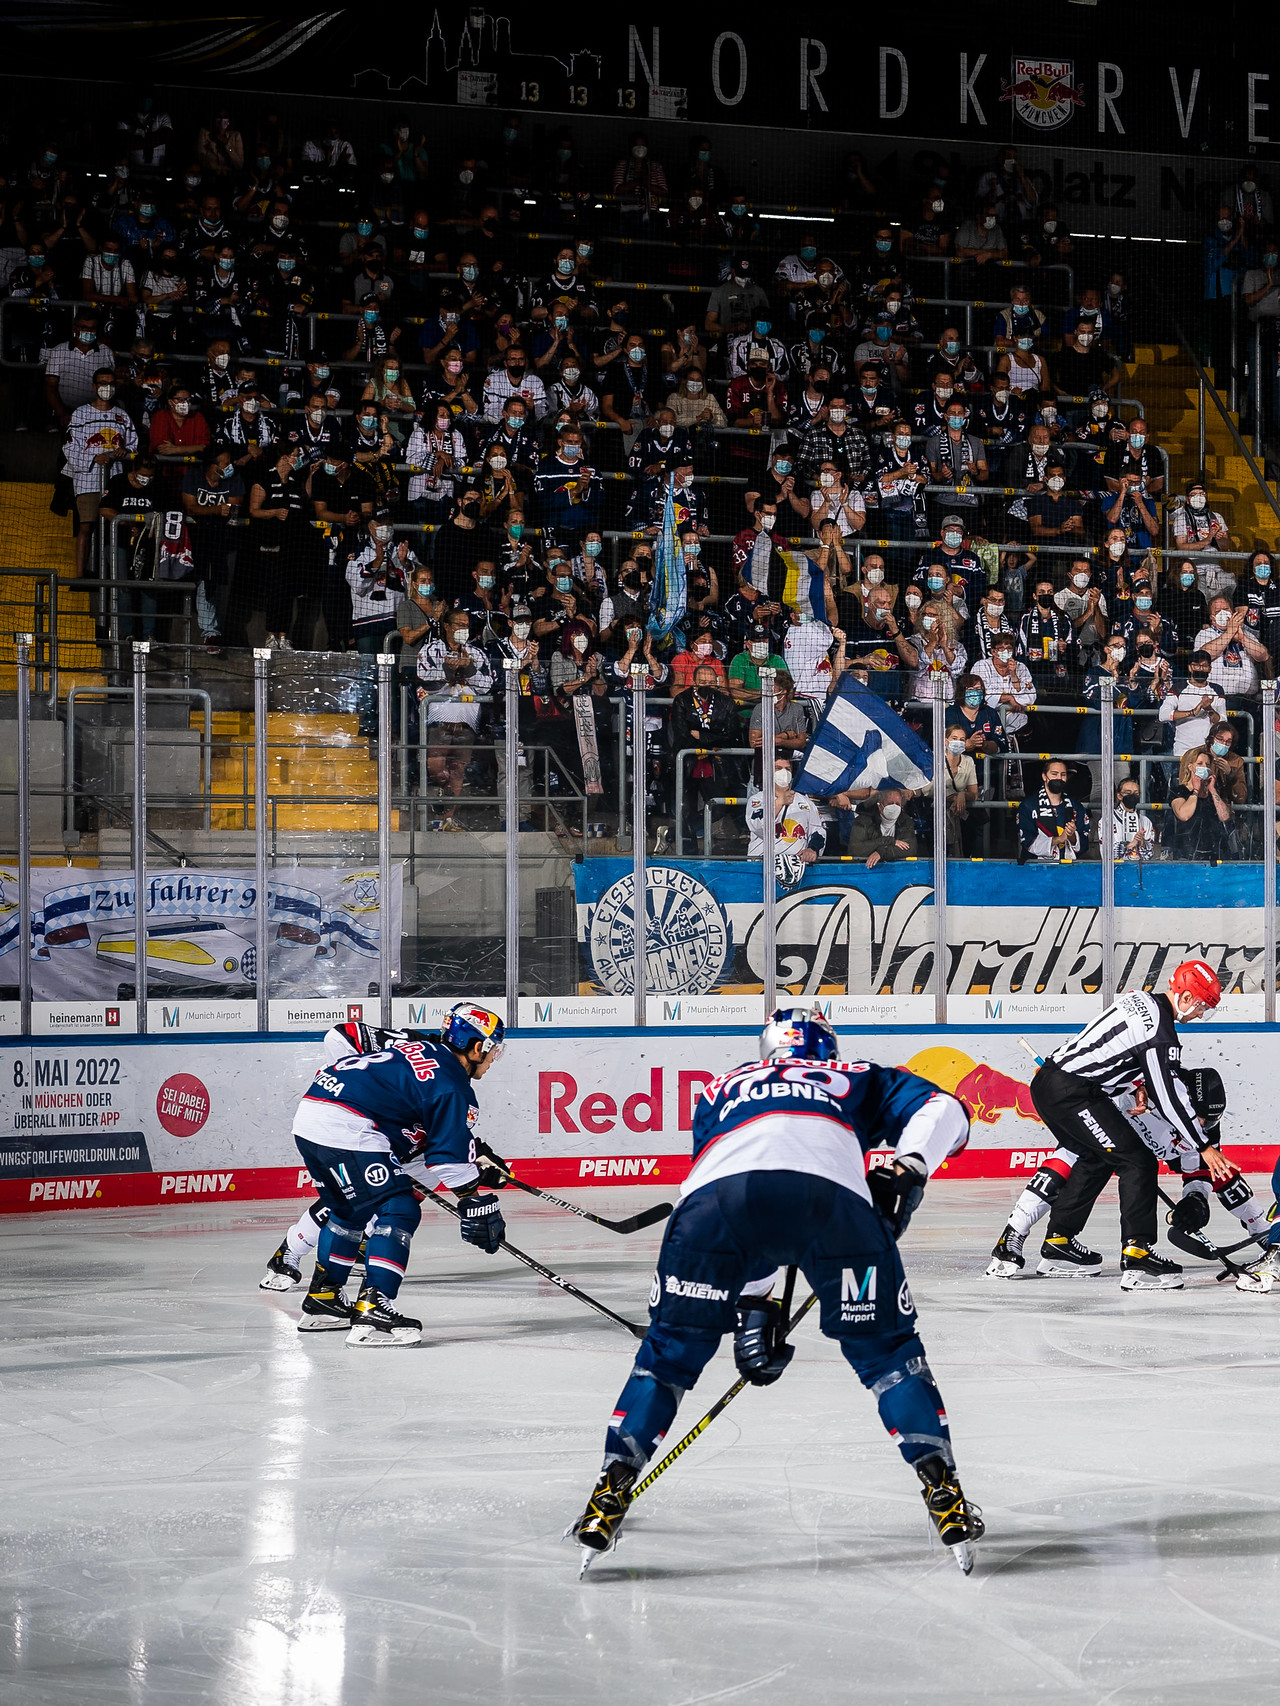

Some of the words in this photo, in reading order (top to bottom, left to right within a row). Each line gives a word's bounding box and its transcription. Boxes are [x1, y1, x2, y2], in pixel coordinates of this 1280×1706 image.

[1129, 814, 1137, 833] EHC
[215, 1010, 242, 1021] Airport
[287, 1009, 345, 1020] heinemann
[590, 1005, 618, 1016] Airport
[719, 1004, 747, 1015] Airport
[869, 1004, 897, 1014] Airport
[1039, 1003, 1066, 1014] Airport
[49, 1013, 103, 1023] heinemann
[13, 1060, 29, 1087] 8.
[35, 1059, 69, 1087] MAI
[75, 1058, 121, 1086] 2022
[1195, 1072, 1203, 1102] STETSON
[22, 1095, 32, 1109] IN
[35, 1092, 83, 1109] MÜNCHEN
[86, 1092, 112, 1107] ODER
[162, 1087, 177, 1101] SEI
[177, 1091, 207, 1111] DABEI:
[538, 1067, 664, 1134] Red
[14, 1112, 56, 1130] ÜBERALL
[59, 1112, 77, 1128] MIT
[79, 1112, 99, 1127] DER
[100, 1111, 120, 1127] APP
[160, 1103, 183, 1118] LAUF
[183, 1108, 204, 1124] MIT!
[667, 1282, 729, 1301] BULLETIN
[841, 1302, 876, 1313] Munich
[841, 1312, 876, 1322] Airport
